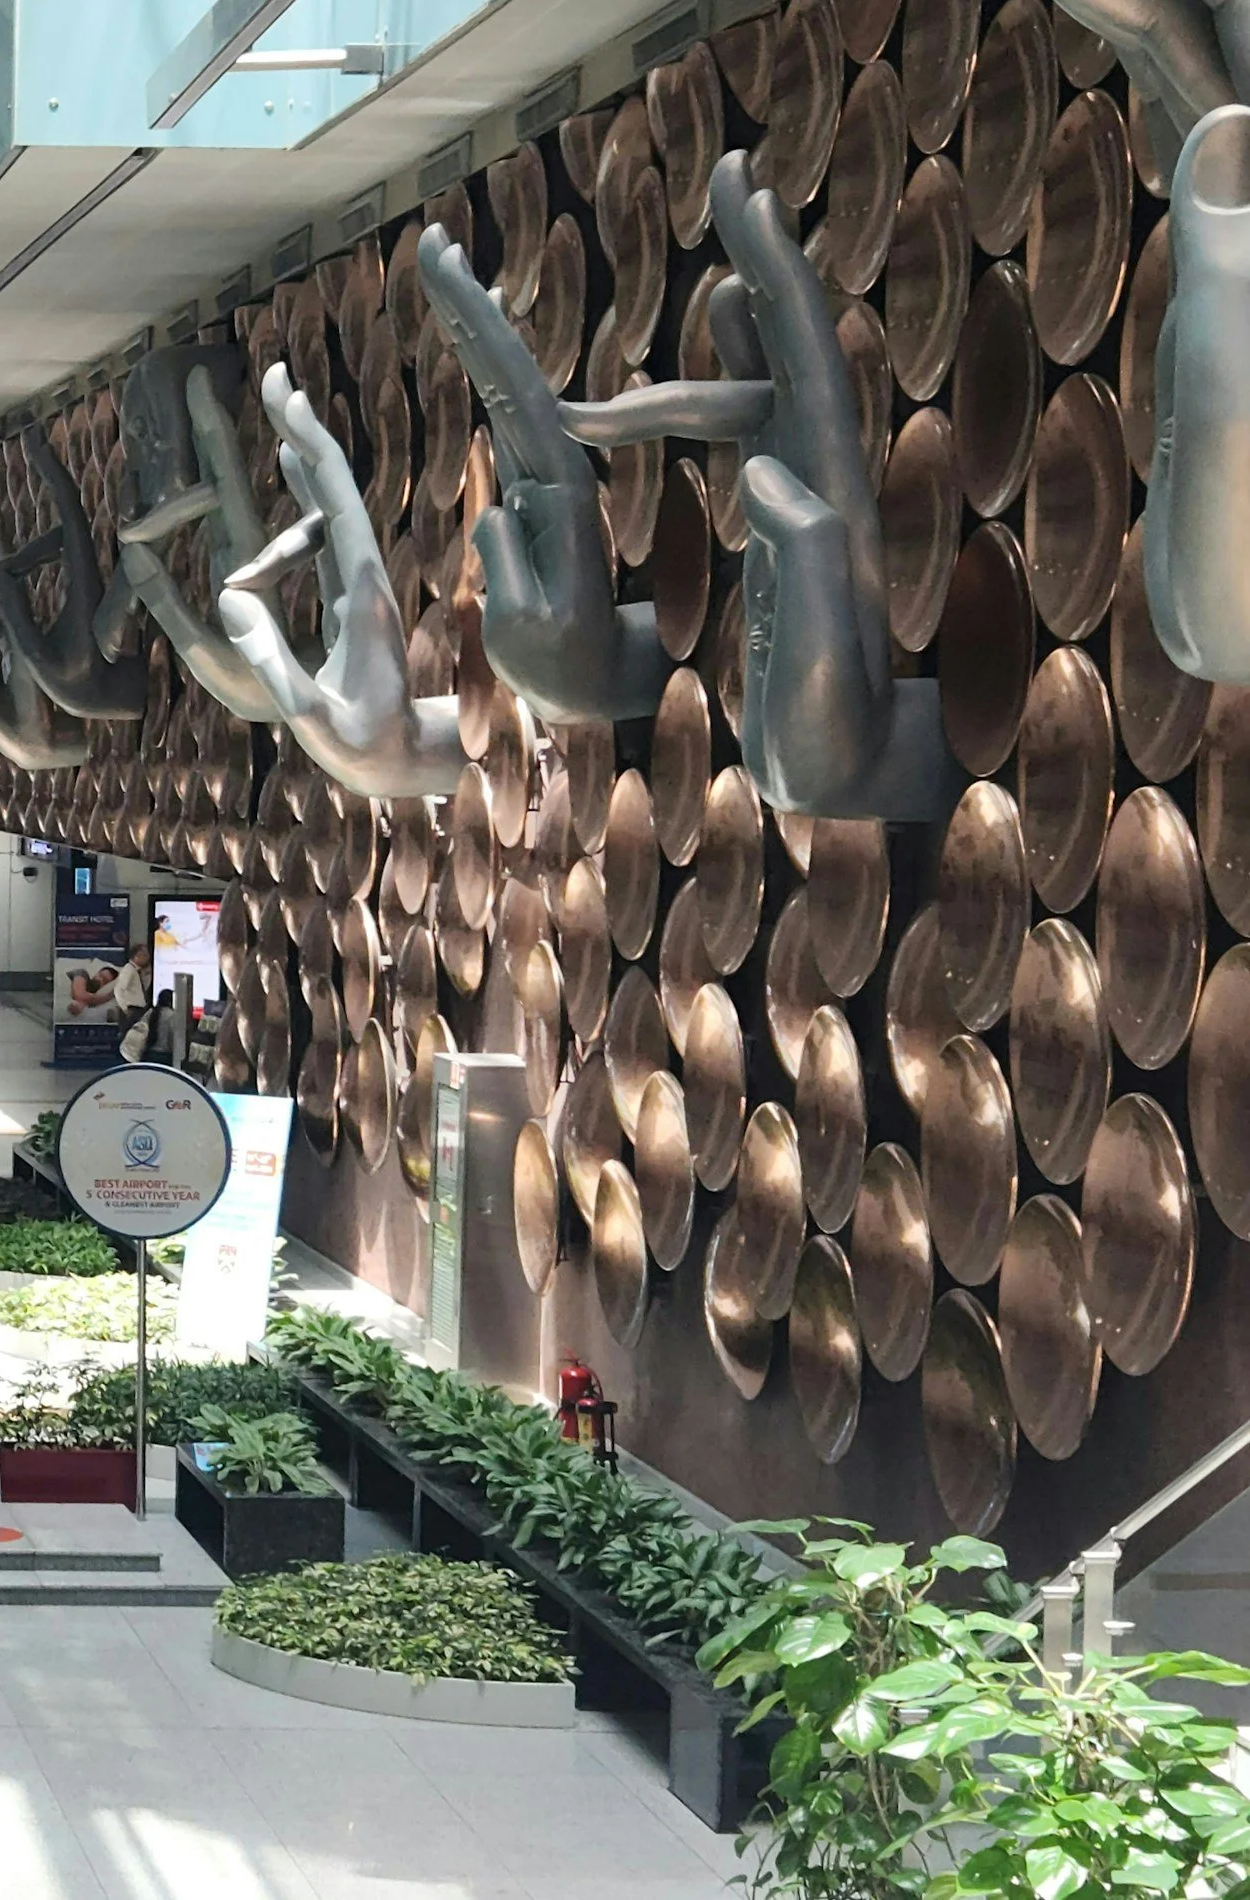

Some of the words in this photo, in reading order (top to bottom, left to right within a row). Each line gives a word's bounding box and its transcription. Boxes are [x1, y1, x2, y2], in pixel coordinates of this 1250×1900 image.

[94, 1179, 120, 1189] BEST
[121, 1180, 168, 1190] AIRPORT
[96, 1190, 168, 1200] CONSECUTIVE
[170, 1191, 201, 1201] YEAR
